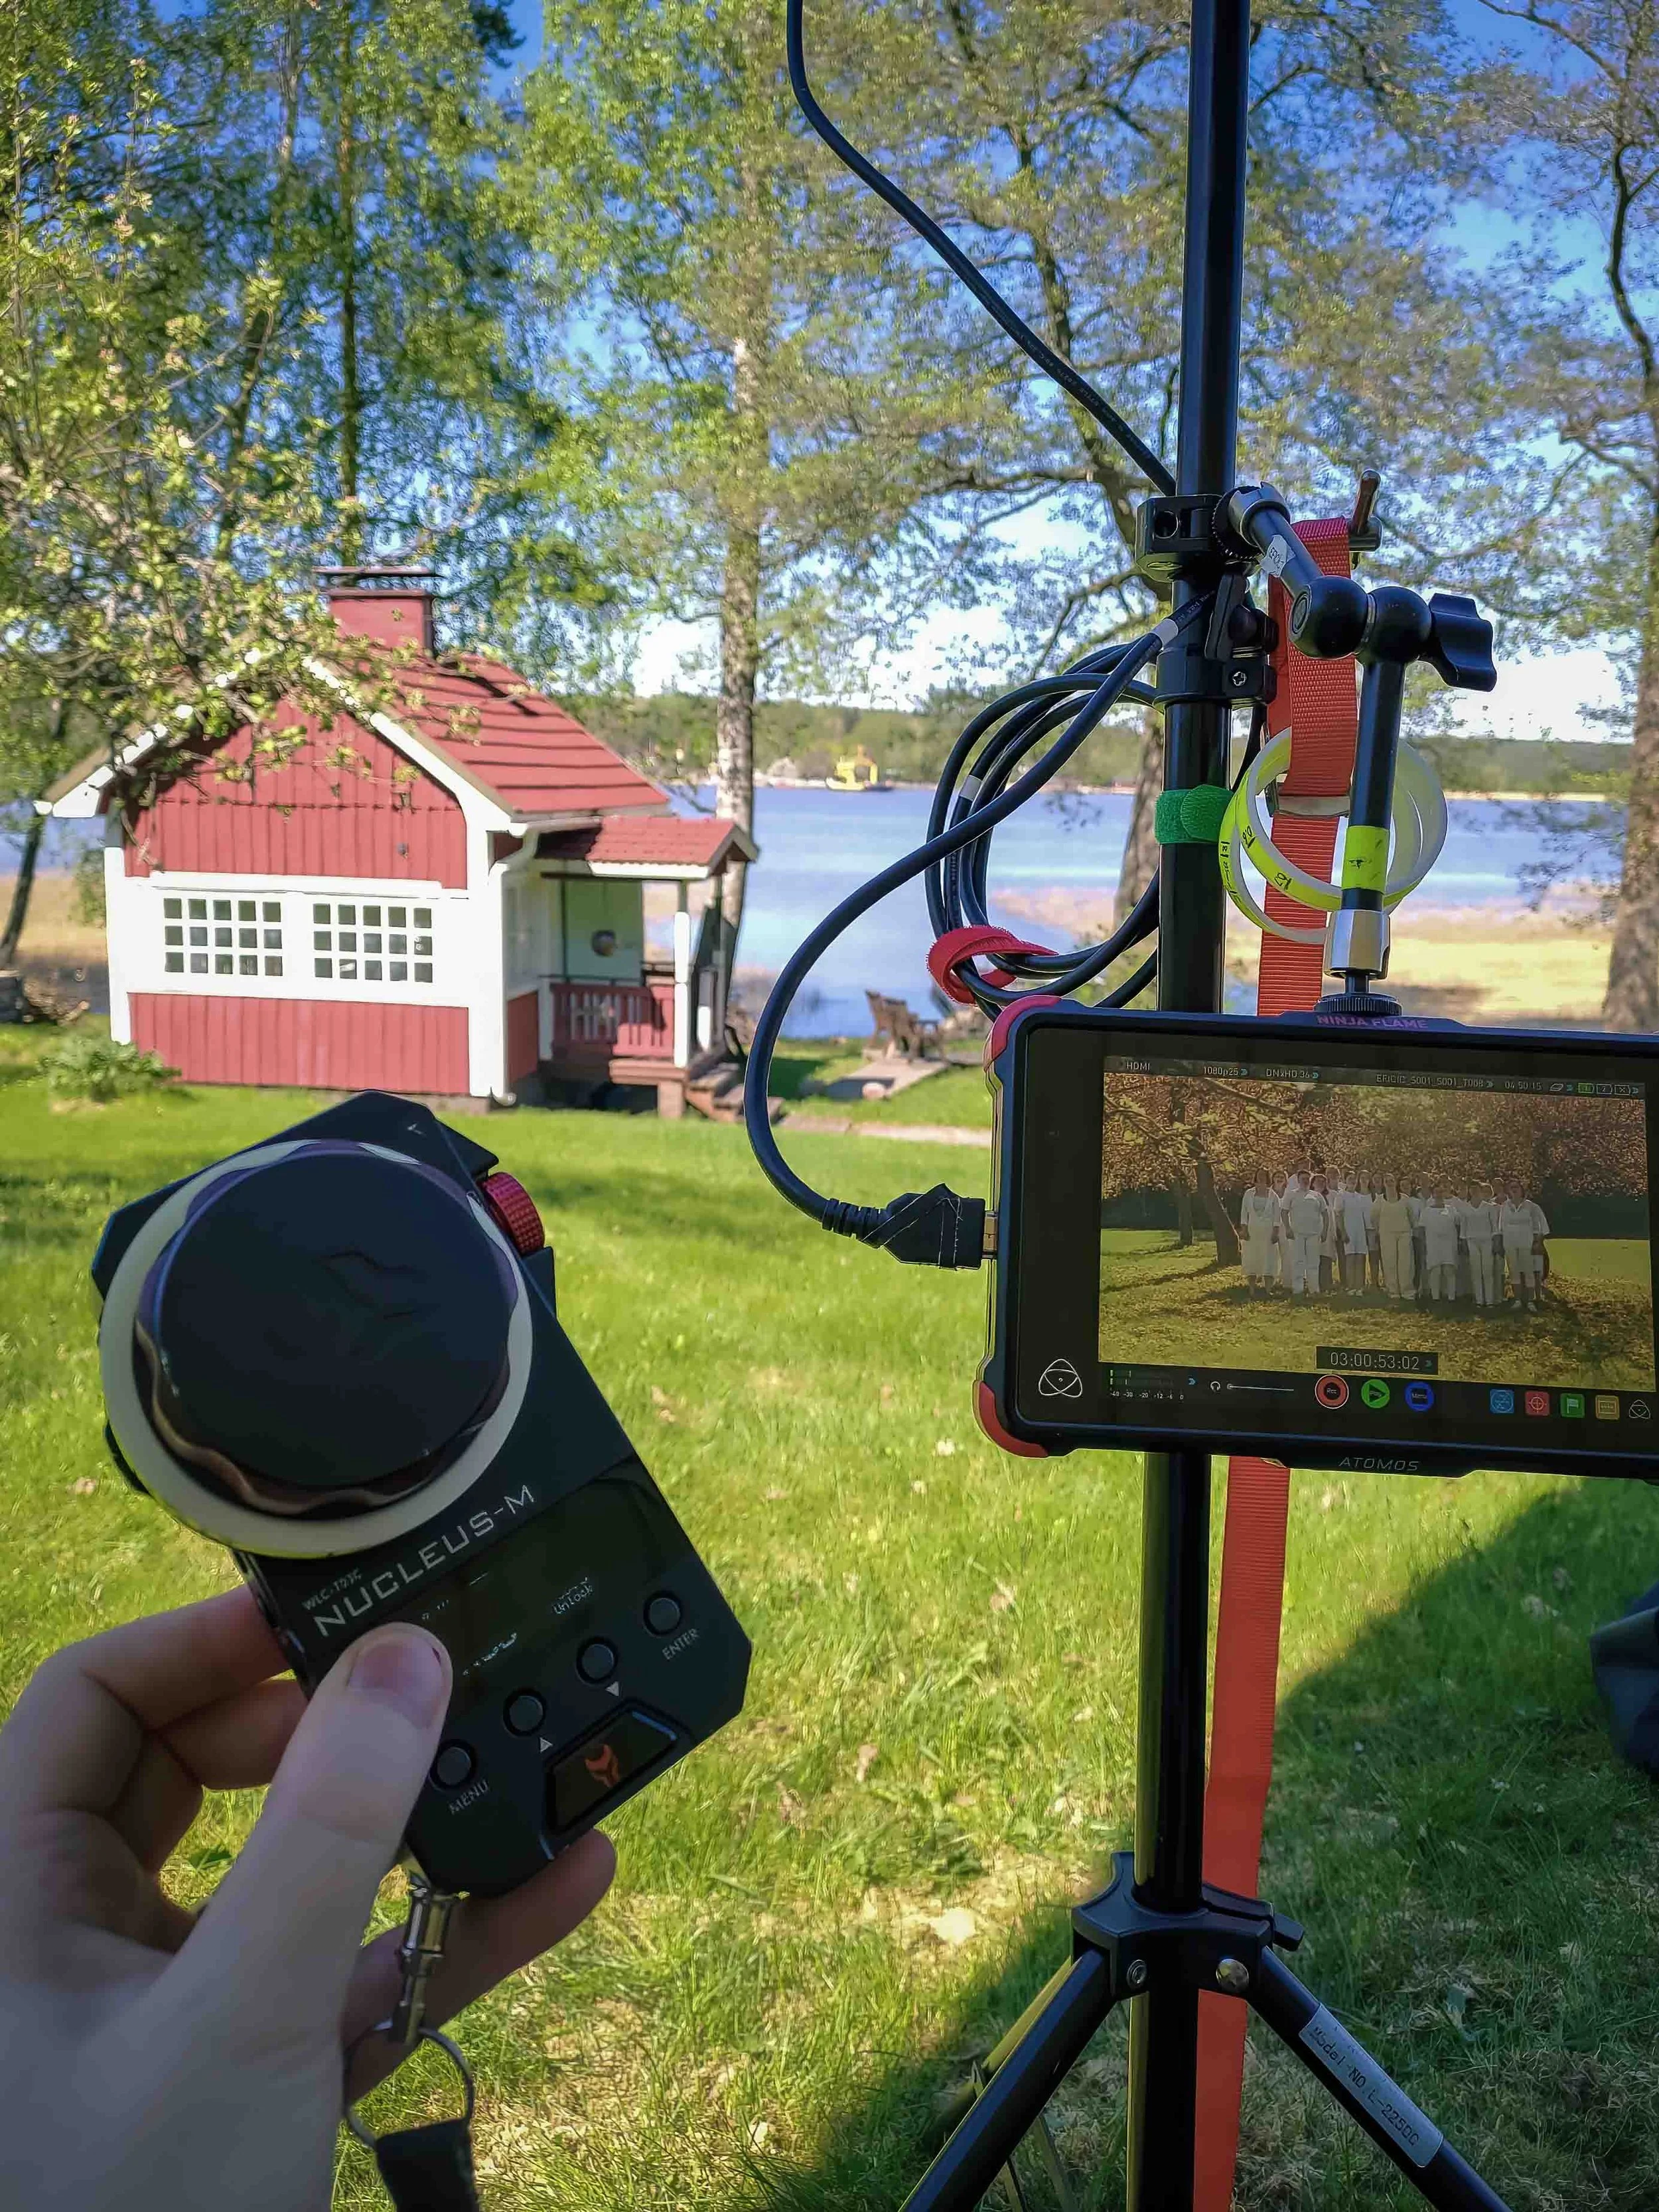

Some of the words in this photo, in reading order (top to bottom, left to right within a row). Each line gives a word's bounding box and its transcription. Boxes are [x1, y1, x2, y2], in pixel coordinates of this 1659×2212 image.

[1317, 1015, 1368, 1026] NINJA
[1370, 1018, 1428, 1028] FLAME
[1126, 1062, 1151, 1071] HDMI
[1203, 1066, 1239, 1076] 1080p25
[1330, 1351, 1420, 1371] 03:00:53:02
[1338, 1456, 1419, 1472] ATOMOS
[313, 1484, 535, 1637] NUCLEUS-M
[661, 1627, 700, 1660] ENTER
[447, 1778, 489, 1816] MENU
